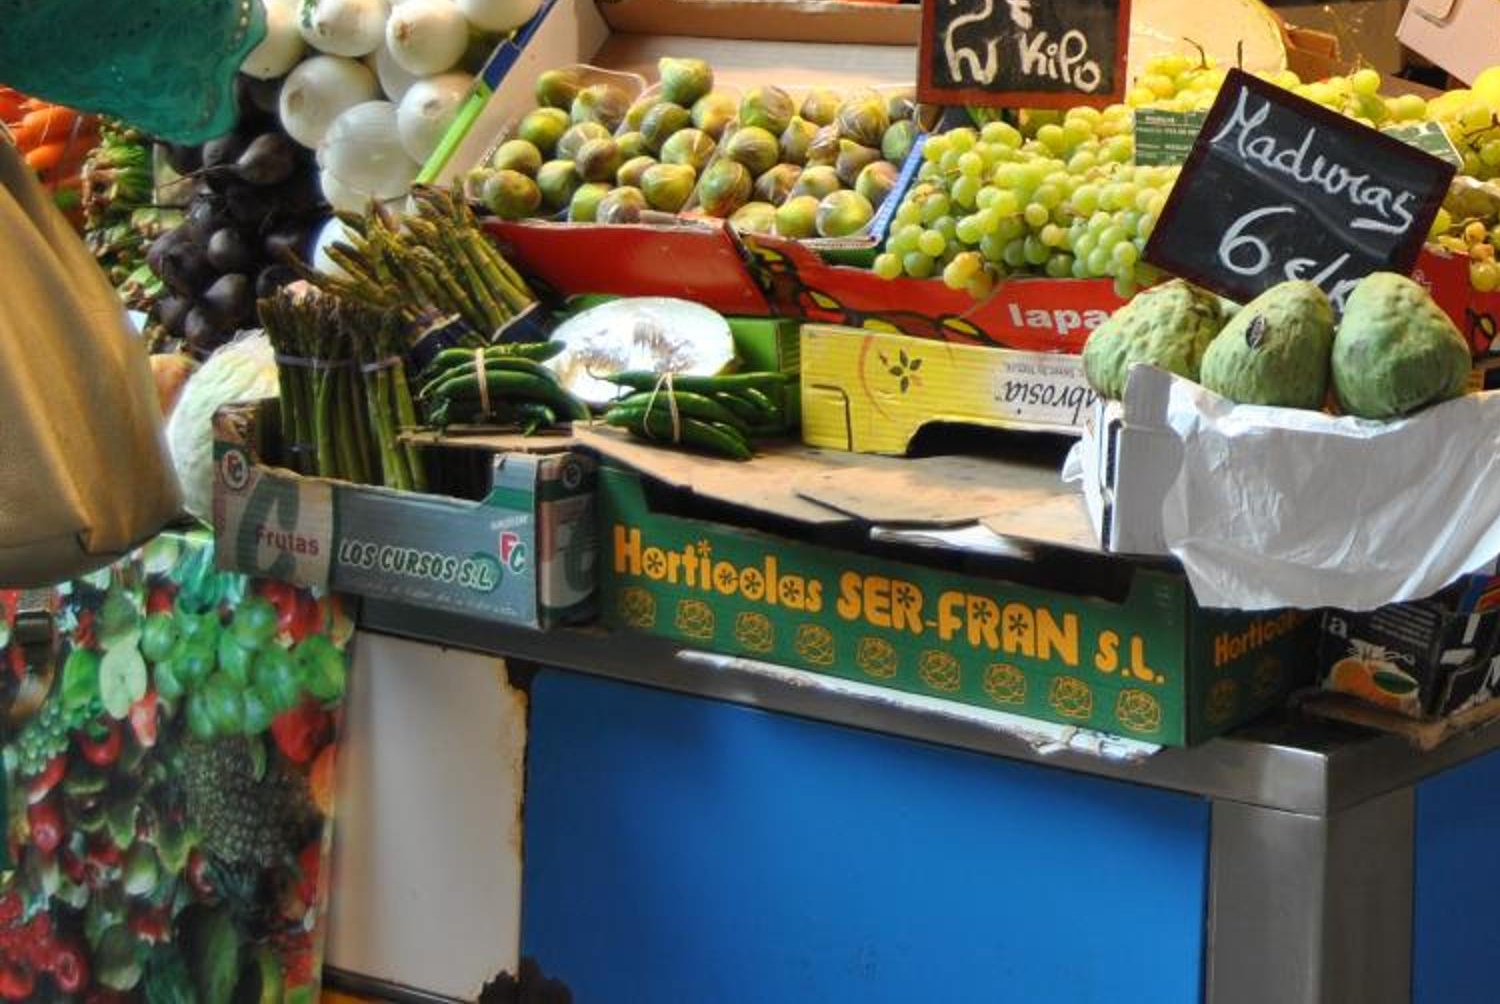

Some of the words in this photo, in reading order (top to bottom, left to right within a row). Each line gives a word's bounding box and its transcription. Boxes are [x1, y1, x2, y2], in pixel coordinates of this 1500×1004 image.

[1210, 85, 1416, 235] Maduras
[1218, 205, 1298, 276] 6
[256, 523, 320, 557] Frutas
[338, 537, 378, 569] LOS
[379, 543, 458, 583] CURSOS
[614, 525, 823, 613] Horticolas
[837, 570, 1080, 667] SER-FRAN
[1095, 634, 1167, 684] S.L.
